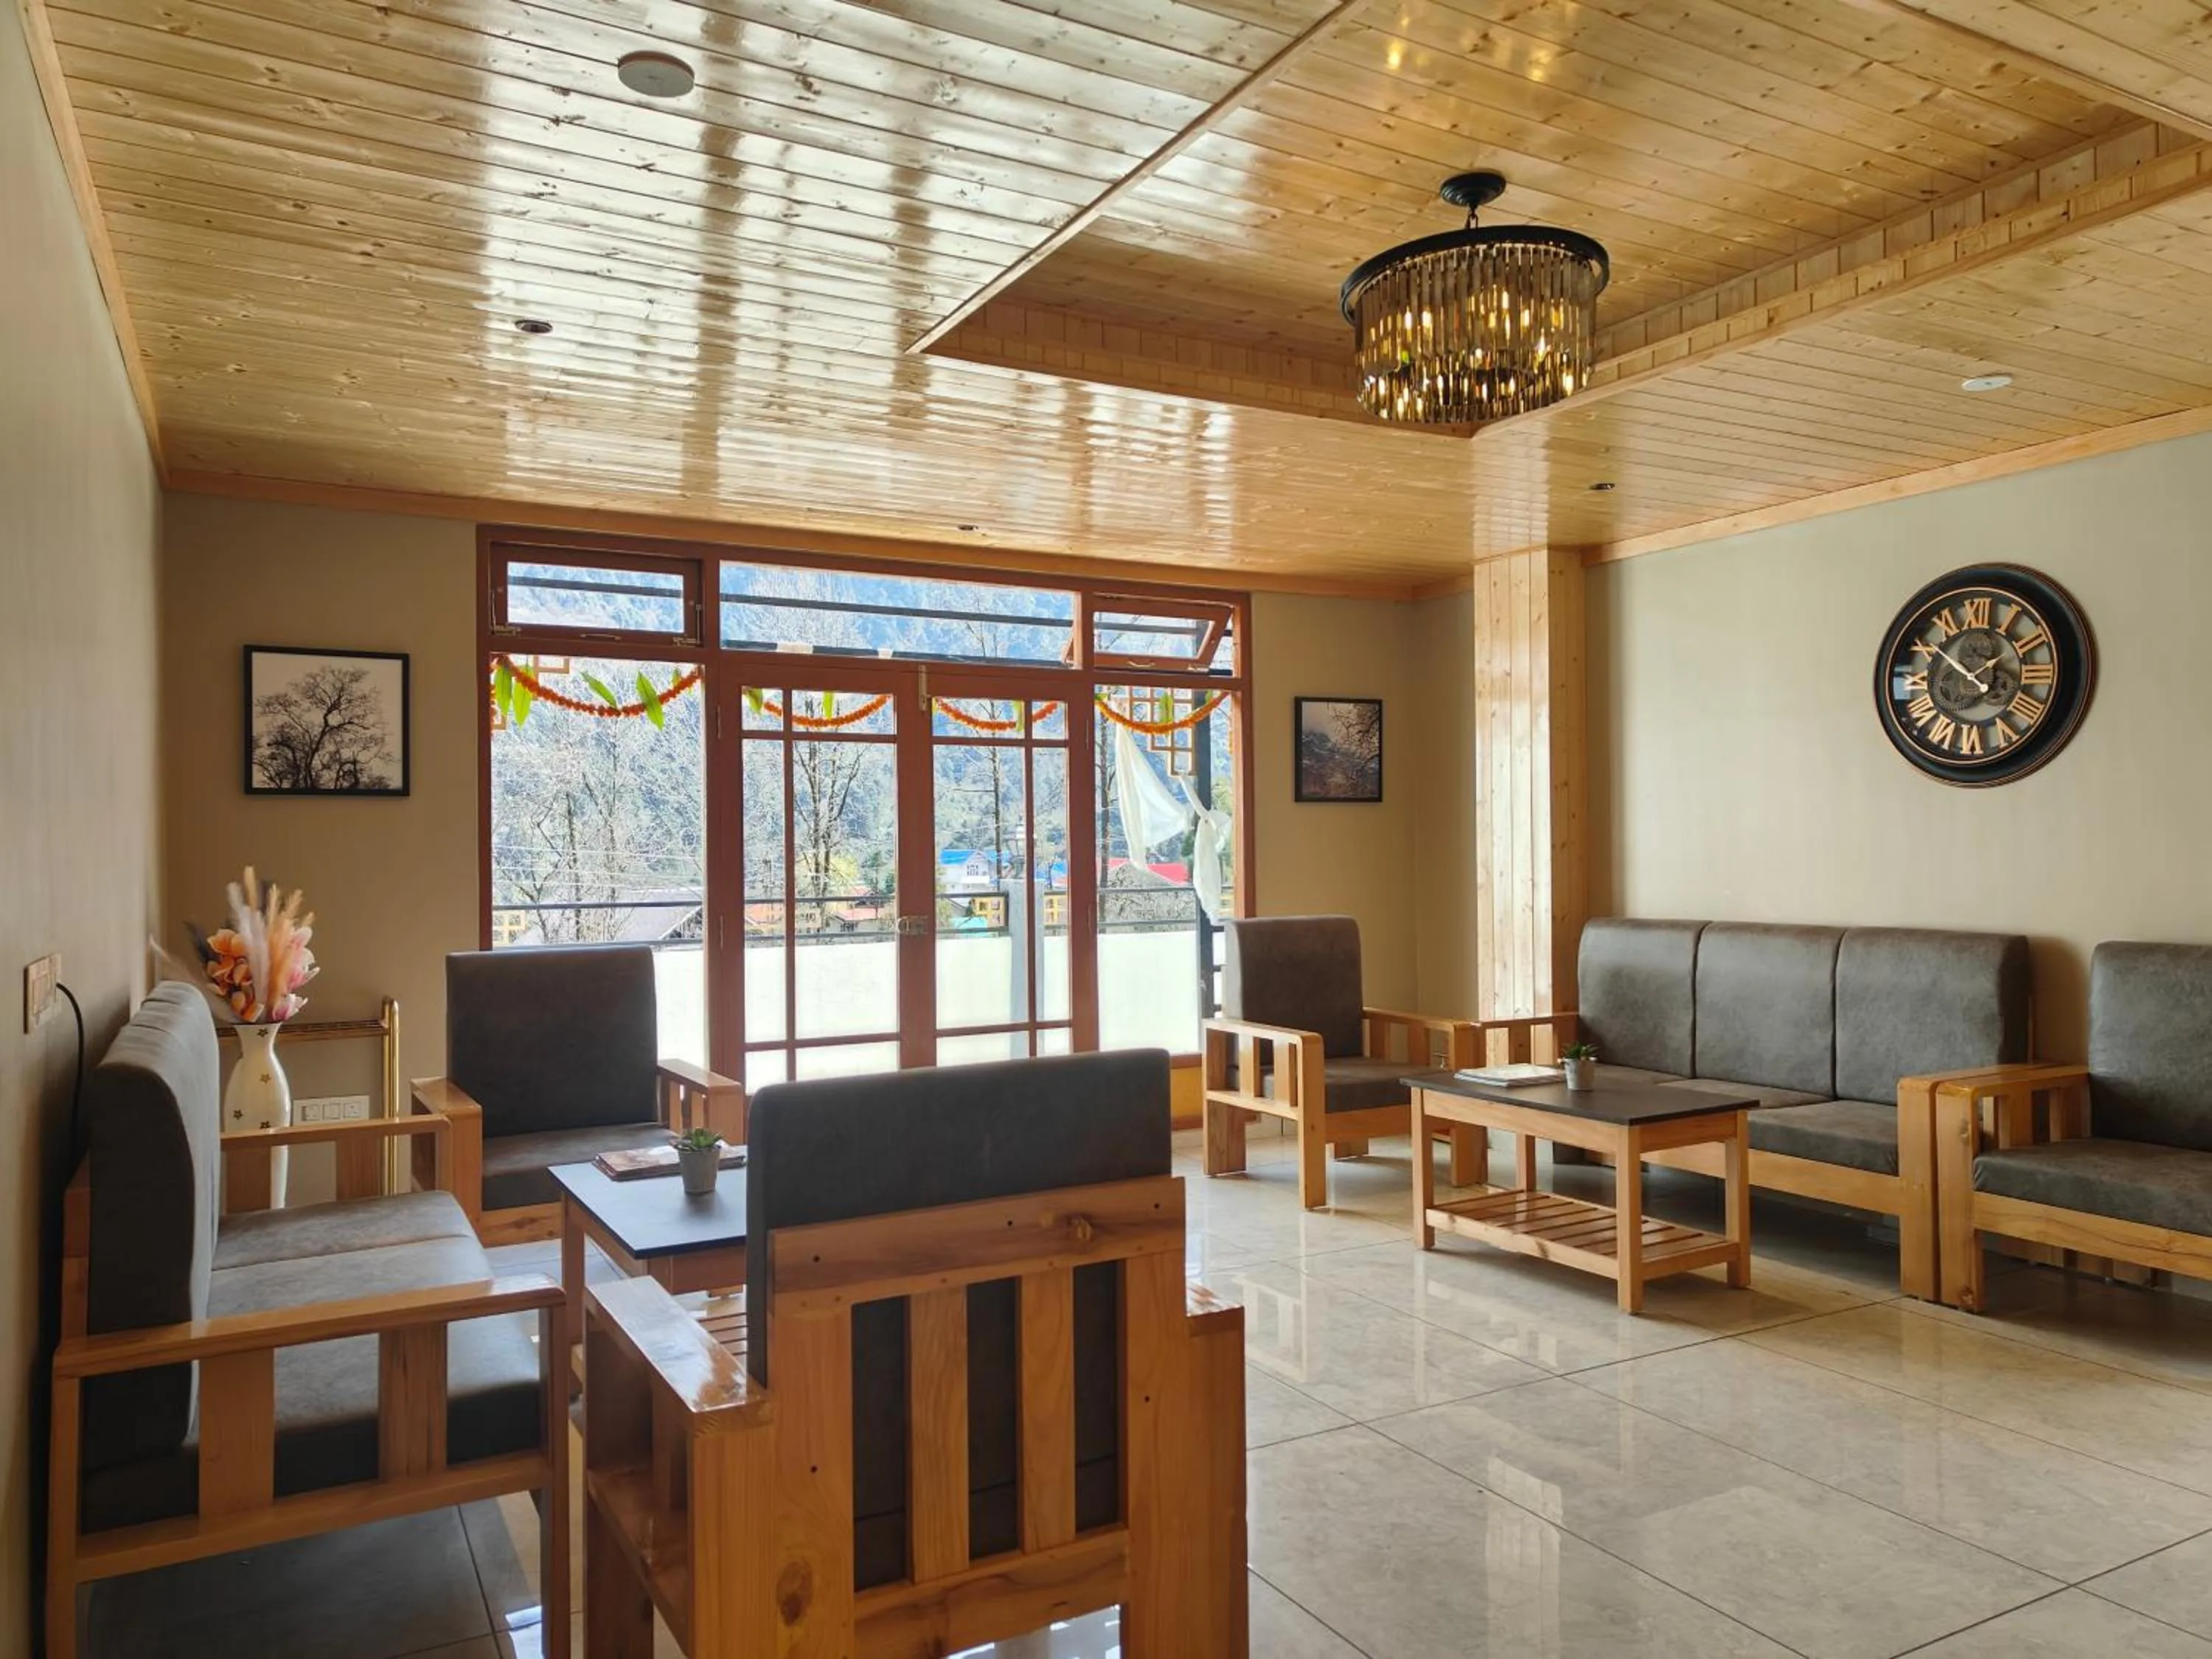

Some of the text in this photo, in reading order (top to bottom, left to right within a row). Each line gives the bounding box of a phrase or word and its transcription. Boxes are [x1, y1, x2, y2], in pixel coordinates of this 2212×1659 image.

[1931, 608, 1960, 642] XI
[1963, 597, 1992, 630] XII
[1996, 602, 2022, 636] I
[2011, 625, 2049, 658] II
[2021, 664, 2053, 684] III
[1960, 724, 1983, 754] VI
[1995, 717, 2020, 748] V
